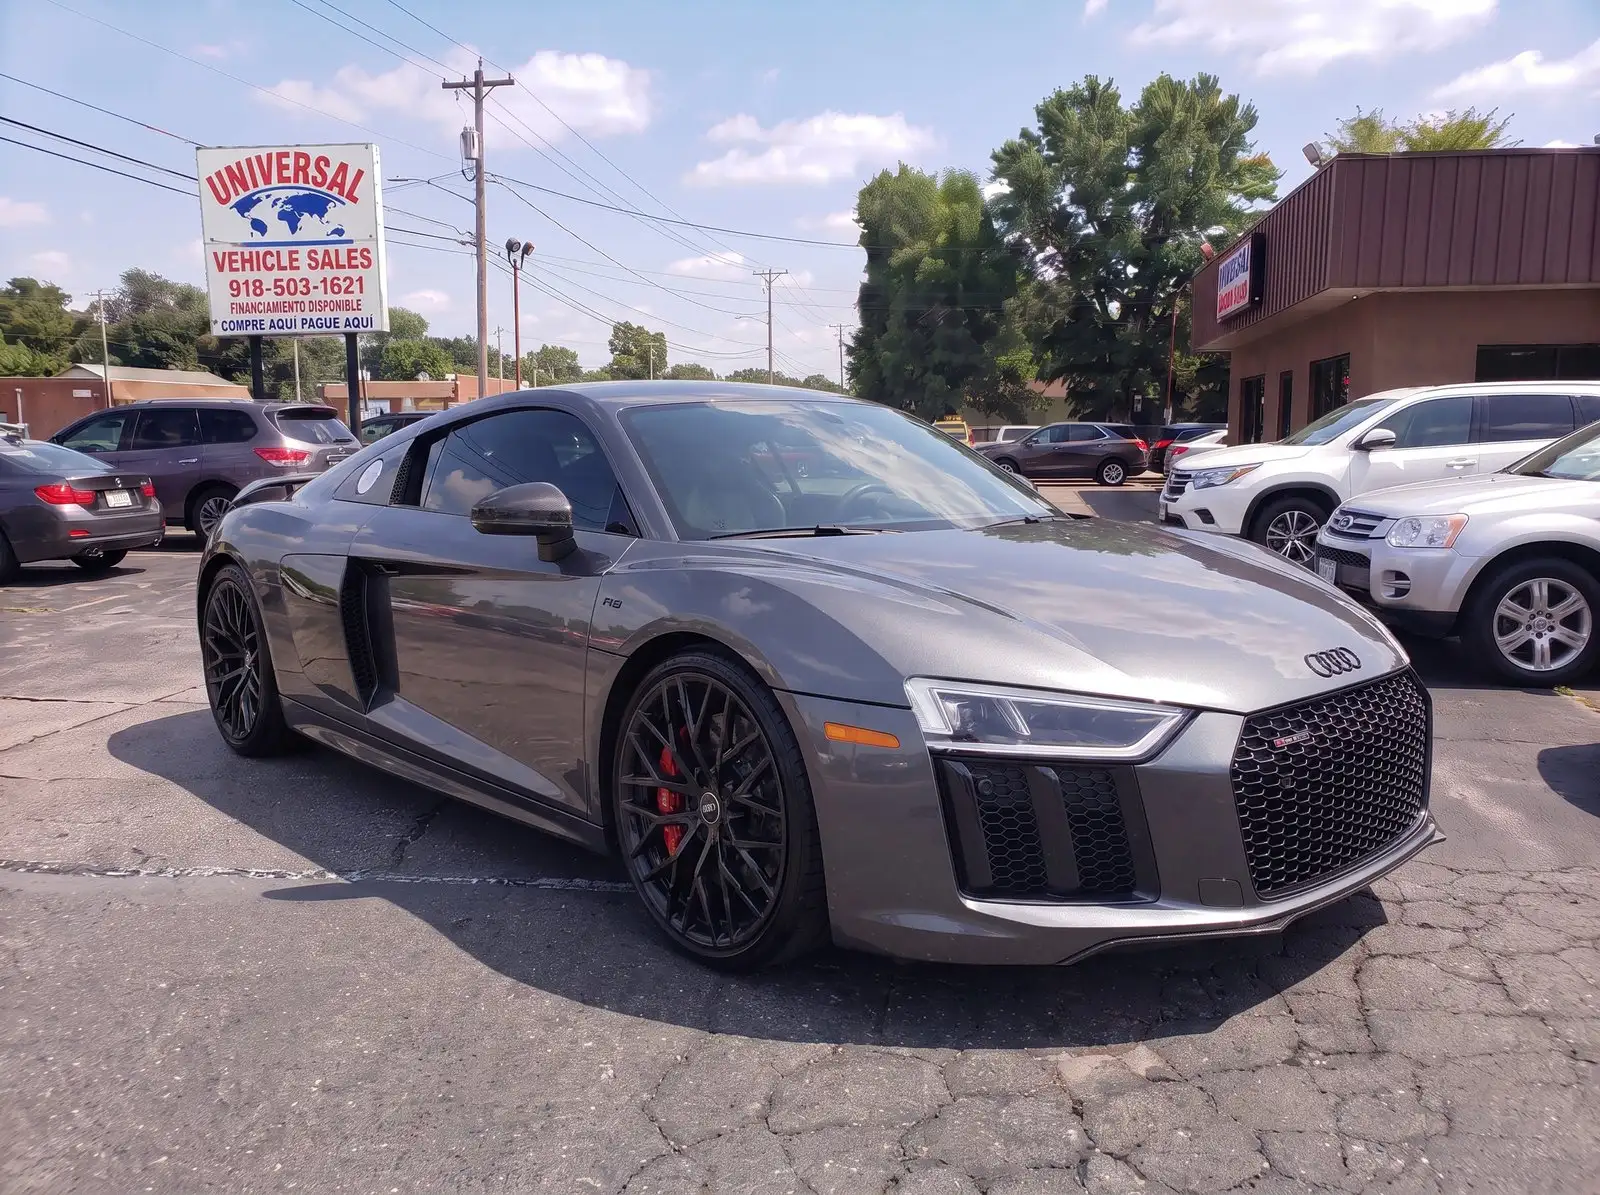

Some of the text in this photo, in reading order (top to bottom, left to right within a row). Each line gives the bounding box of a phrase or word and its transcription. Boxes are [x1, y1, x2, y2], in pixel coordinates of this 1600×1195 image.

[206, 152, 365, 206] UNIVERSAL
[213, 248, 372, 273] VEHICLE SALES
[229, 276, 364, 298] 918-503-1621
[230, 299, 362, 315] FINANCIAMIENTO DISPONIBLE
[221, 314, 373, 332] COMPRE AQUÍ PAGUE AQUÍ
[603, 597, 623, 609] R8
